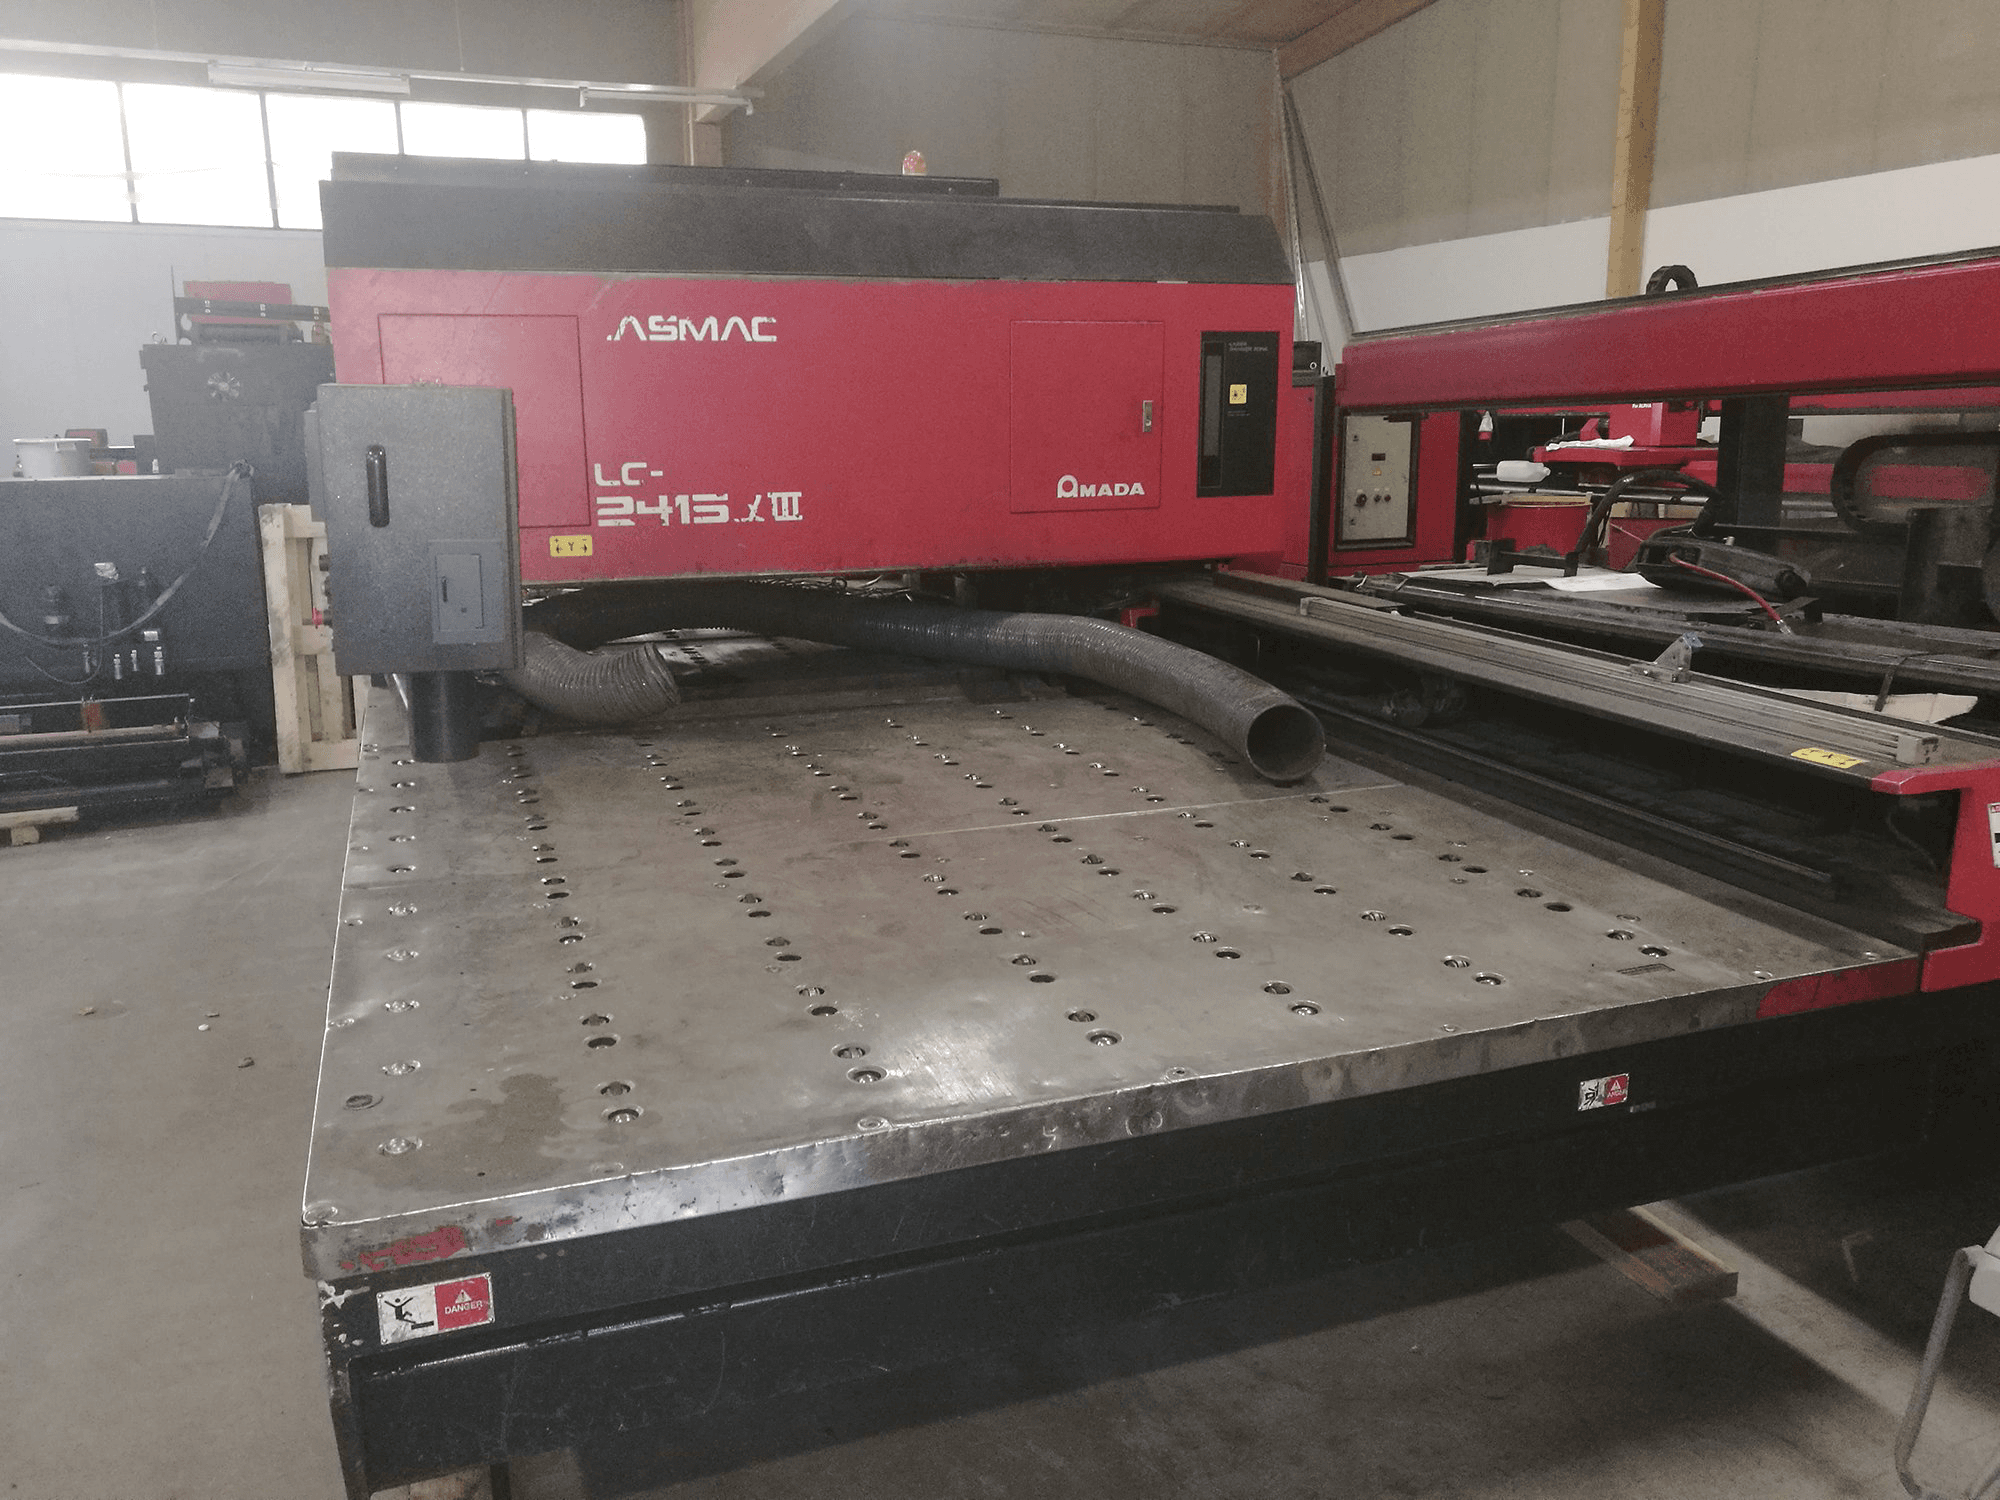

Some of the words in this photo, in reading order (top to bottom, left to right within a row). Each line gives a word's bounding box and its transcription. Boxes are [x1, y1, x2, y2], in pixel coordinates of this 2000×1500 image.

[594, 462, 663, 486] LC-
[1057, 474, 1145, 498] AMADA
[444, 1300, 483, 1314] DANGER
